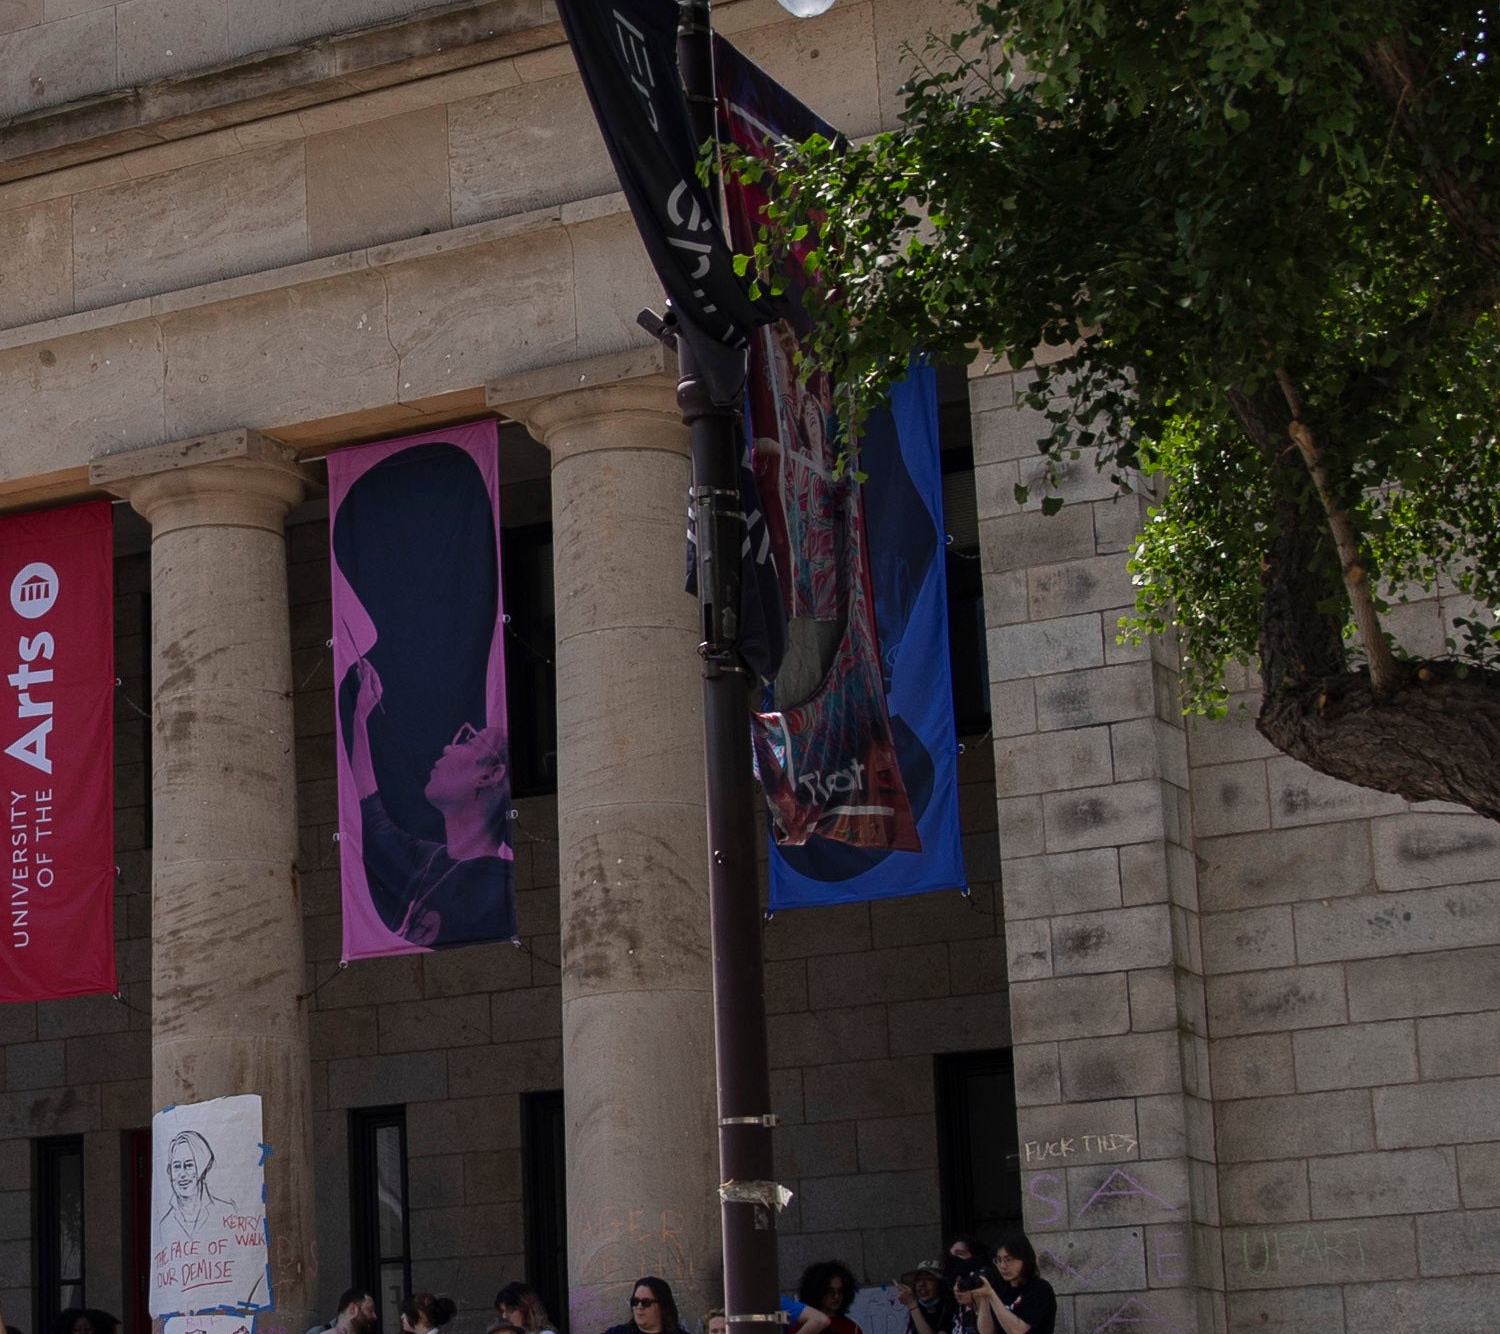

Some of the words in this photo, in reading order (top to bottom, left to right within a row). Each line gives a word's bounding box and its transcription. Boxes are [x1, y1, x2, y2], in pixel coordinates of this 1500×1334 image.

[5, 631, 55, 774] Arts
[35, 789, 54, 843] THE
[11, 789, 29, 949] UNIVERSITY
[35, 849, 54, 888] OF
[1025, 1138, 1076, 1163] FUCK
[222, 1215, 262, 1232] KERRY
[170, 1241, 201, 1261] FACE
[208, 1239, 229, 1256] OF
[235, 1233, 265, 1247] WALK
[157, 1270, 179, 1289] OUR
[181, 1260, 235, 1286] DEMISE
